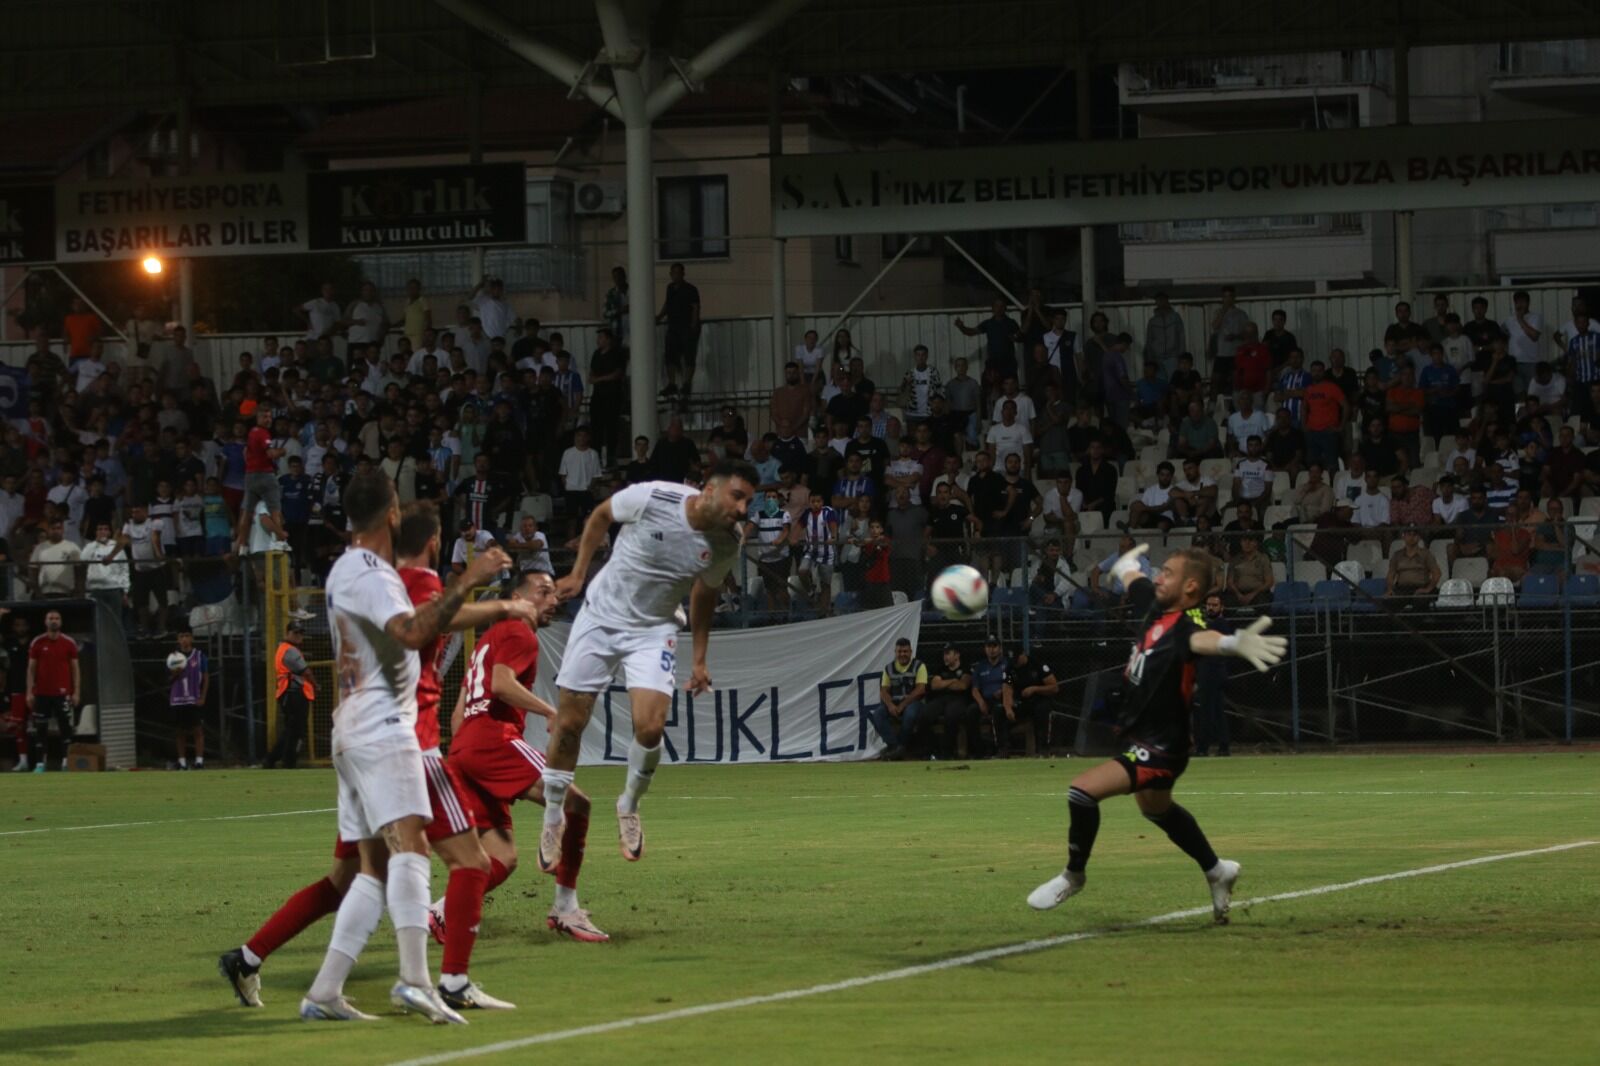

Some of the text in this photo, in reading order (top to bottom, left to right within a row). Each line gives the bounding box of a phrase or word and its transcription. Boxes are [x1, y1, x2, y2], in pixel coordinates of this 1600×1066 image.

[78, 183, 283, 214] FETHİYESPOR'A
[340, 177, 494, 217] Krlık
[974, 168, 1057, 203] BELLİ
[65, 220, 213, 259] BAŞARILAR
[221, 216, 299, 246] DİLER
[341, 218, 495, 248] Kuyumculuk
